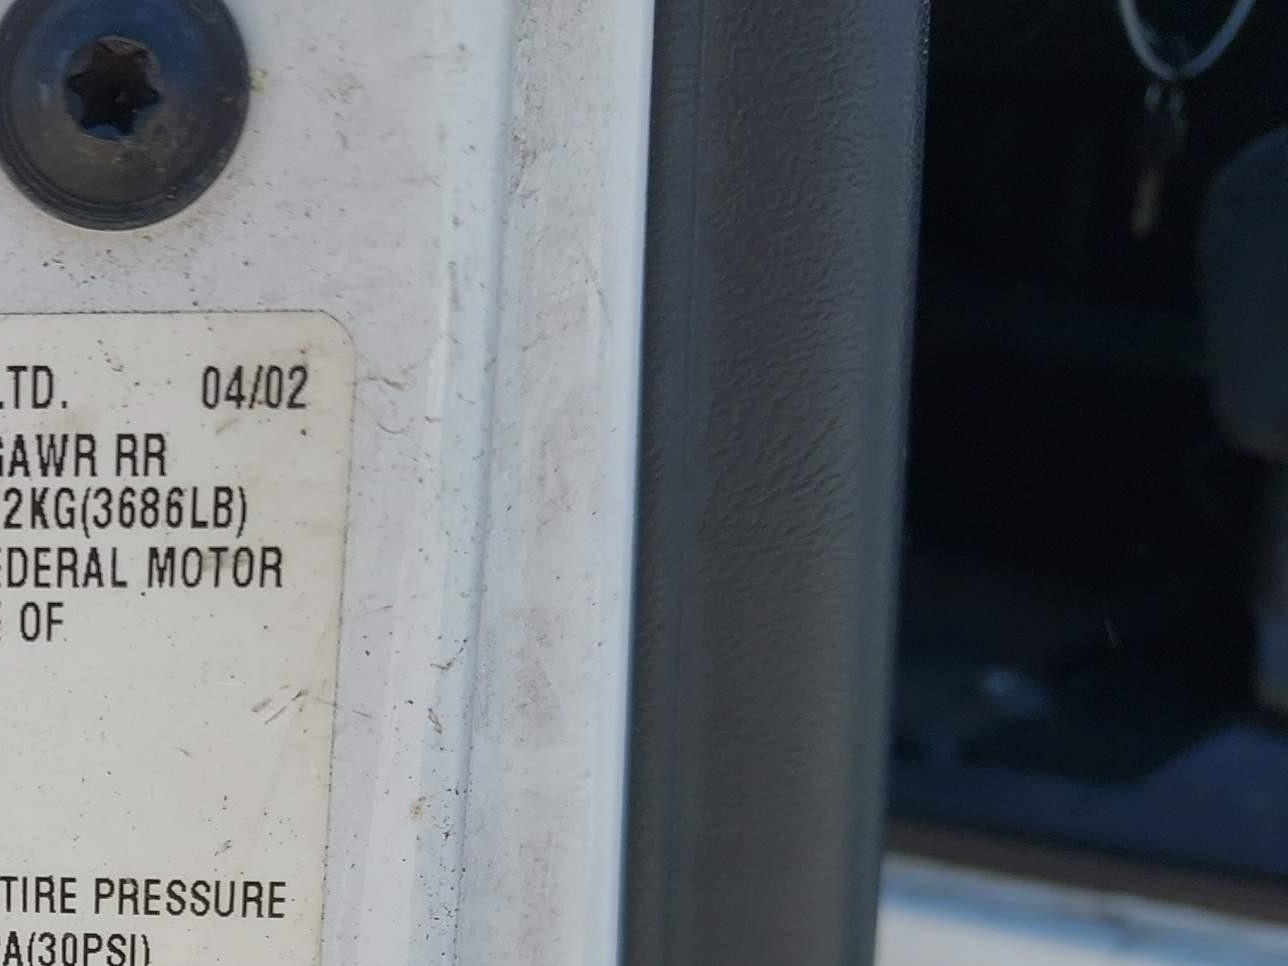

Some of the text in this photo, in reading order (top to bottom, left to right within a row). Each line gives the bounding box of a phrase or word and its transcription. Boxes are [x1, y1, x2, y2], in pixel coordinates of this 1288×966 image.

[202, 365, 308, 409] 04/02
[115, 433, 167, 477] RR
[148, 546, 282, 588] MOTOR
[20, 601, 64, 642] OF
[0, 875, 77, 914] TIRE
[94, 878, 286, 918] PRESSURE
